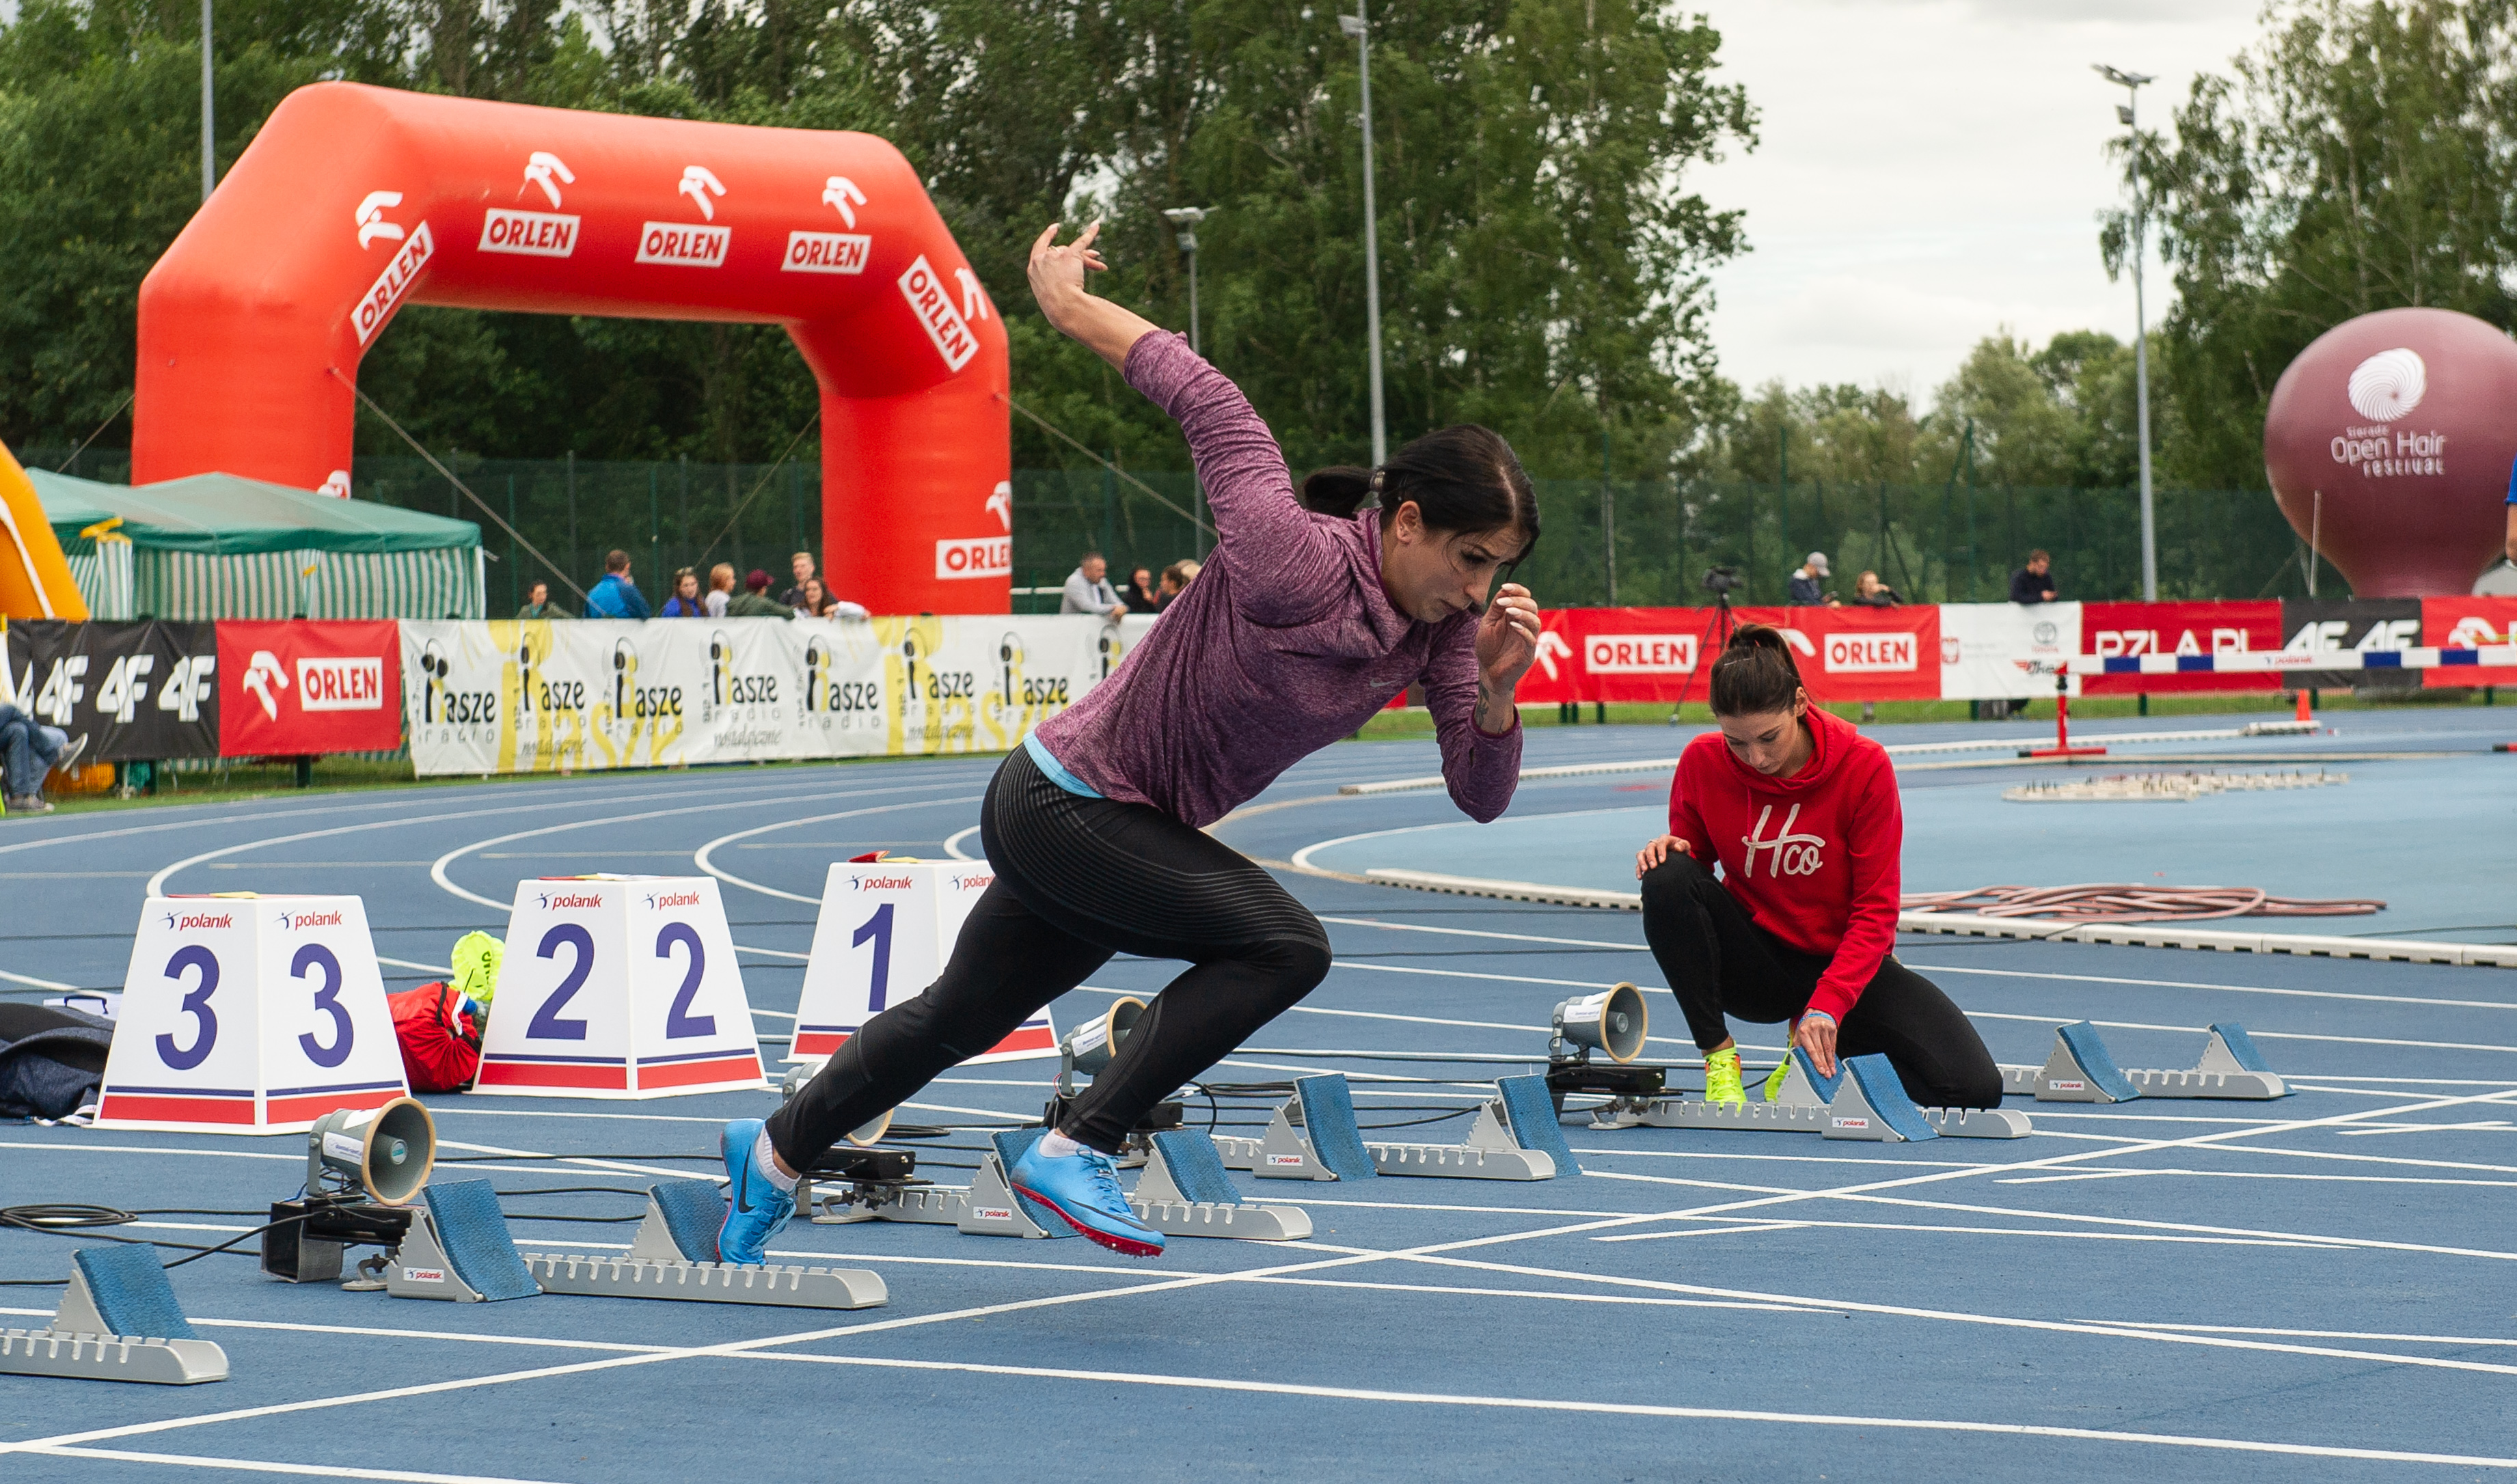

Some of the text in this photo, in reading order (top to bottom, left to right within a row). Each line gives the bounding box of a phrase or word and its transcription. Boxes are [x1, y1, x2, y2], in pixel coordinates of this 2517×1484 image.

[488, 217, 573, 250] ORLEN
[646, 233, 724, 260] ORLEN
[791, 238, 865, 267] ORLEN
[360, 234, 427, 329] ORLEN
[909, 269, 968, 363] ORLEN
[2330, 430, 2447, 467] Open Hair
[945, 544, 1009, 571] ORLE
[1593, 641, 1689, 665] ORLEN
[1832, 640, 1909, 665] ORLEN
[36, 655, 89, 726] 4F
[96, 654, 154, 724] 4F
[158, 655, 216, 722] 4F
[305, 666, 379, 702] ORLEN
[424, 676, 497, 724] nasze
[713, 663, 778, 705] nasze
[806, 670, 879, 712] nasze
[1741, 803, 1825, 878] Hco
[552, 893, 603, 911] polanik
[659, 891, 700, 911] polanik
[863, 876, 913, 892] polanik
[179, 913, 234, 931] polanik
[295, 909, 342, 931] polanik
[852, 903, 895, 1013] 1
[525, 922, 595, 1041] 2
[655, 922, 717, 1040] 2
[155, 945, 220, 1071] 3
[290, 943, 354, 1068] 3
